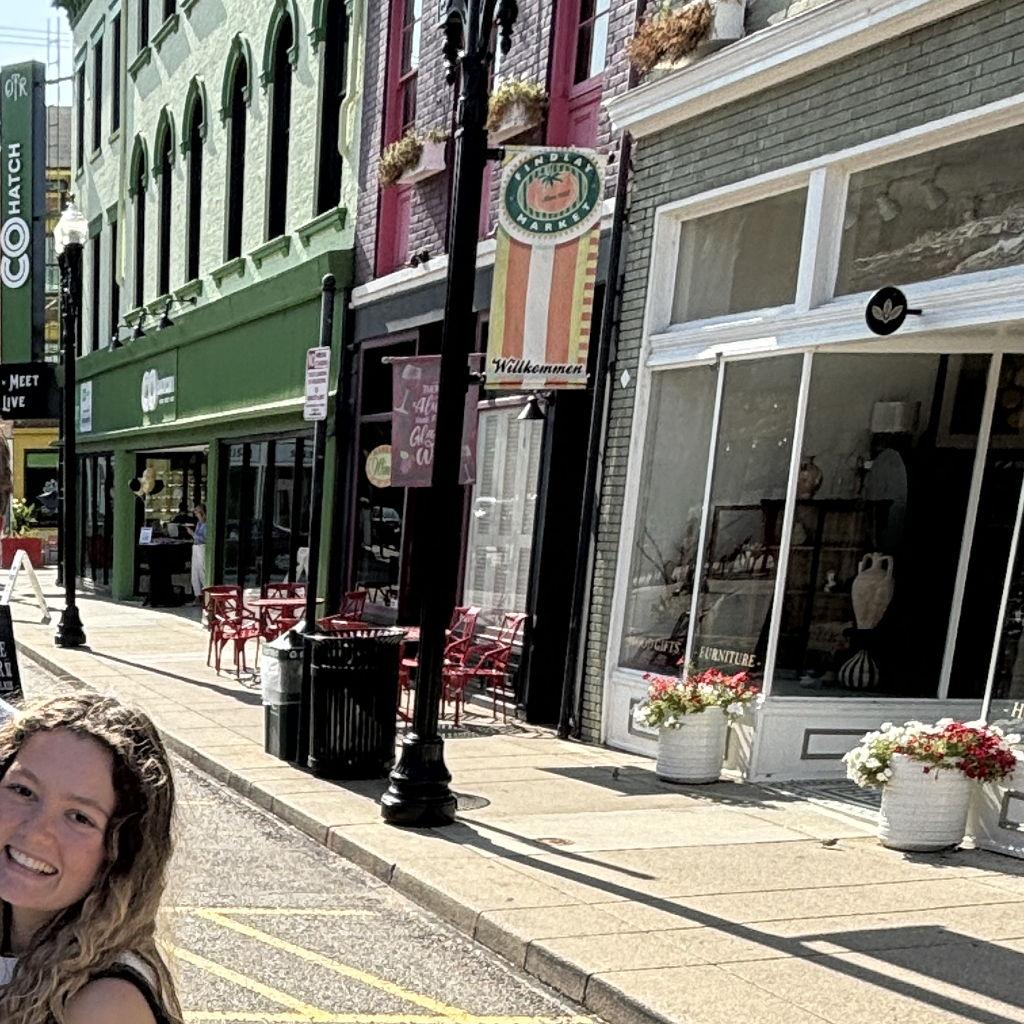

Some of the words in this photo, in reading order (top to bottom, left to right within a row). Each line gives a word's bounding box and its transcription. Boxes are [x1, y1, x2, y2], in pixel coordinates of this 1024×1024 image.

[515, 153, 594, 181] FINDLAY
[516, 202, 591, 231] MARKET
[491, 358, 583, 374] Willkommen
[698, 646, 757, 667] FURNITURE
